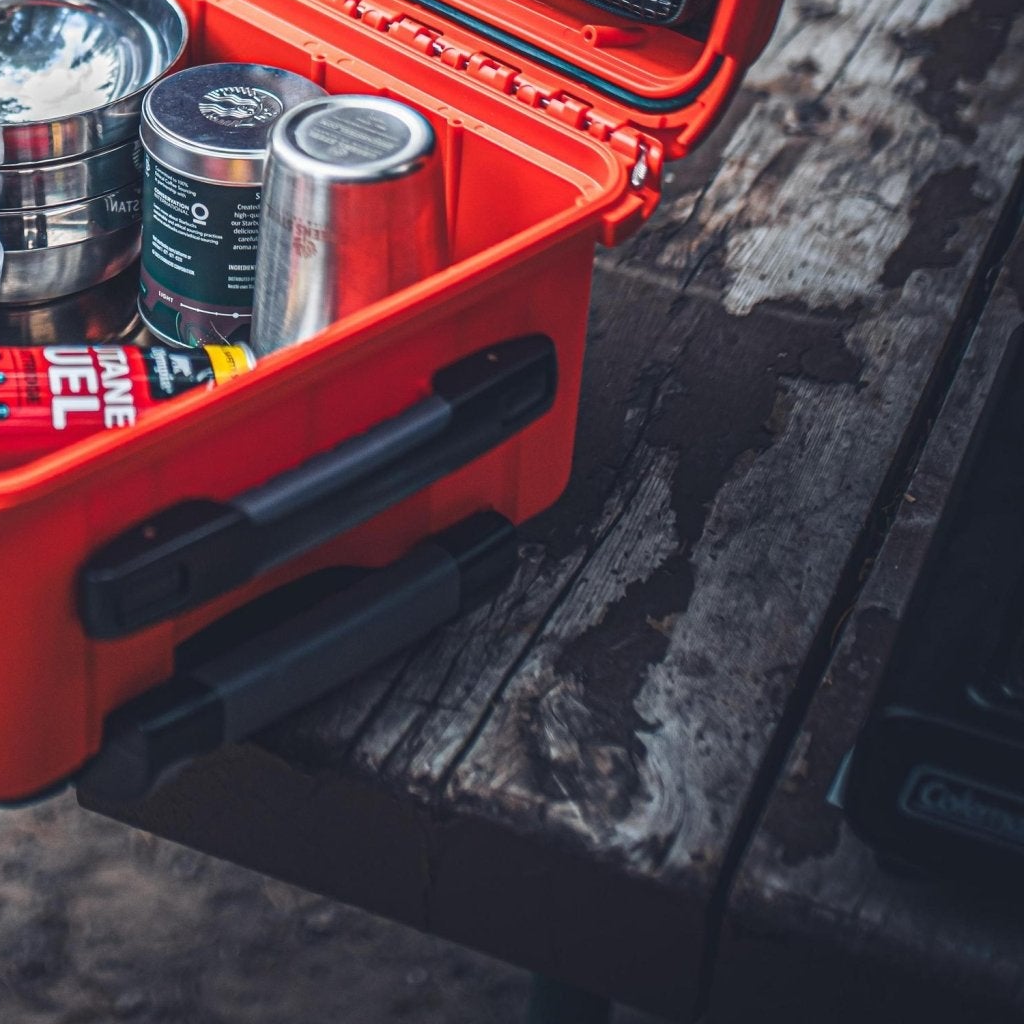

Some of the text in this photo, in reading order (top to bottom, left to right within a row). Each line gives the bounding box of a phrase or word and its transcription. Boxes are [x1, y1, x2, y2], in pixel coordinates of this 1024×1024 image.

[158, 290, 174, 303] LIGHT
[43, 345, 101, 431] UEL
[93, 346, 137, 429] UTANE
